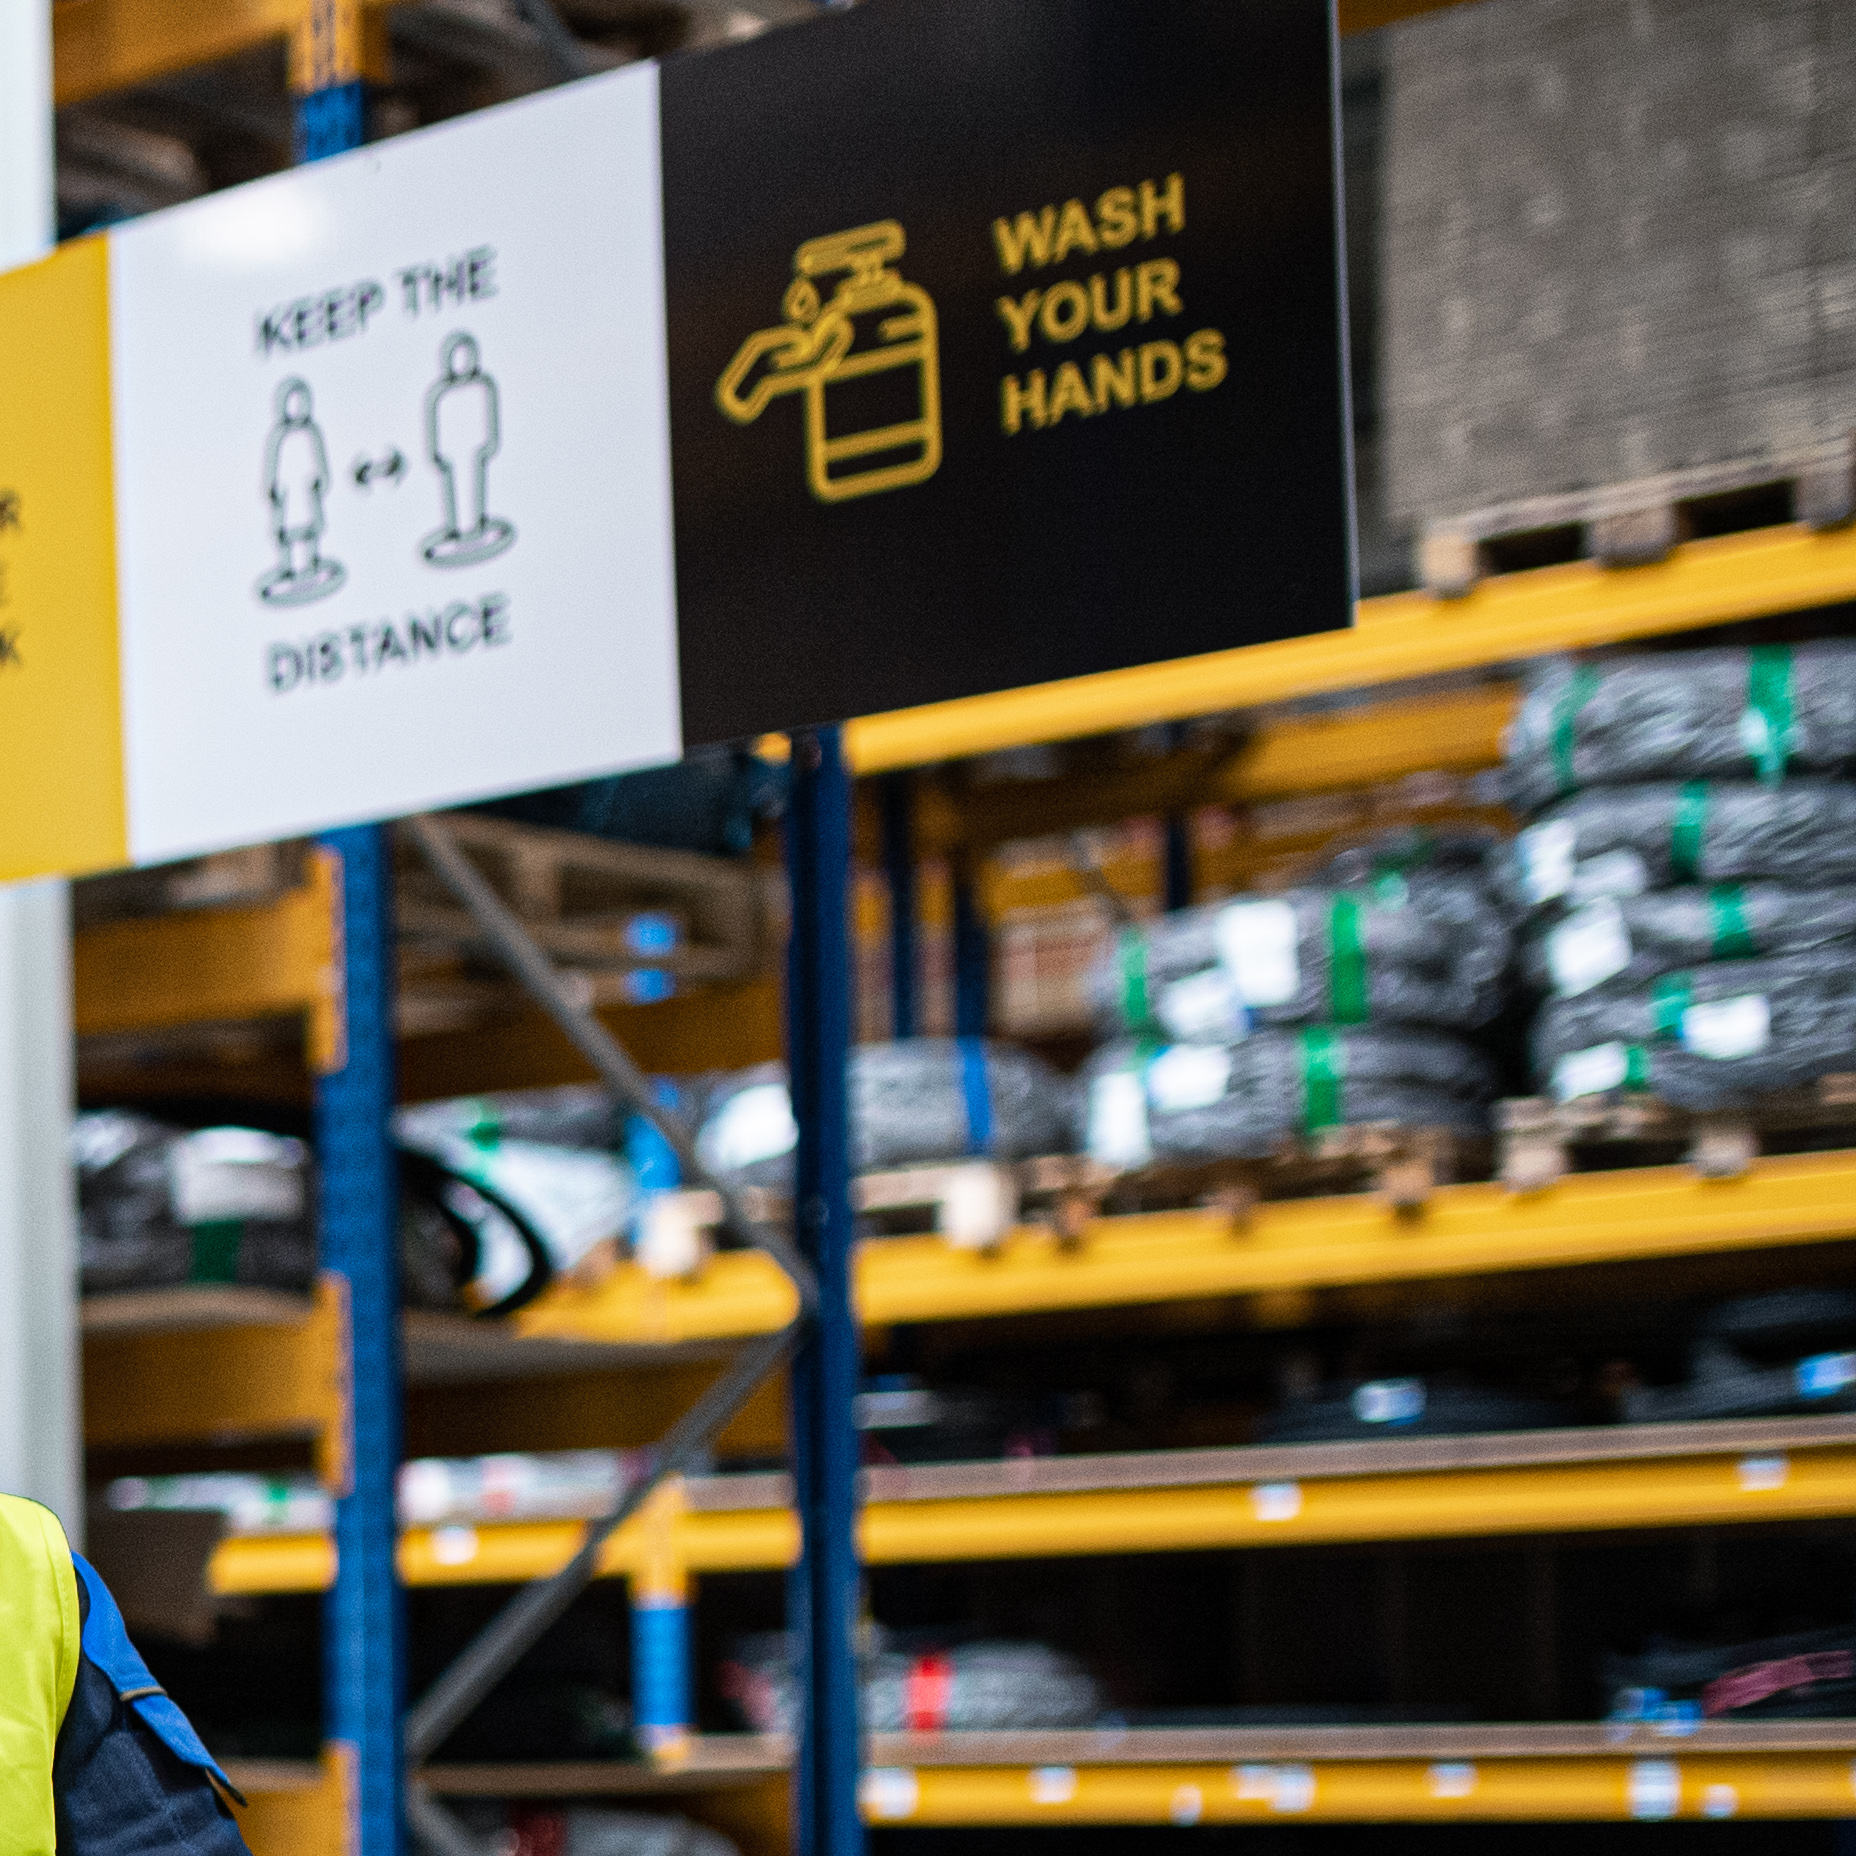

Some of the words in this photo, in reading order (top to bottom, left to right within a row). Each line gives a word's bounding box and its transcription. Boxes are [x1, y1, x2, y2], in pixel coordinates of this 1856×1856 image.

[992, 171, 1186, 275] WASH
[254, 279, 384, 361] KEEP
[393, 245, 498, 317] THE
[996, 257, 1184, 352] YOUR
[1000, 327, 1229, 435] HANDS
[265, 591, 512, 692] DISTANCE
